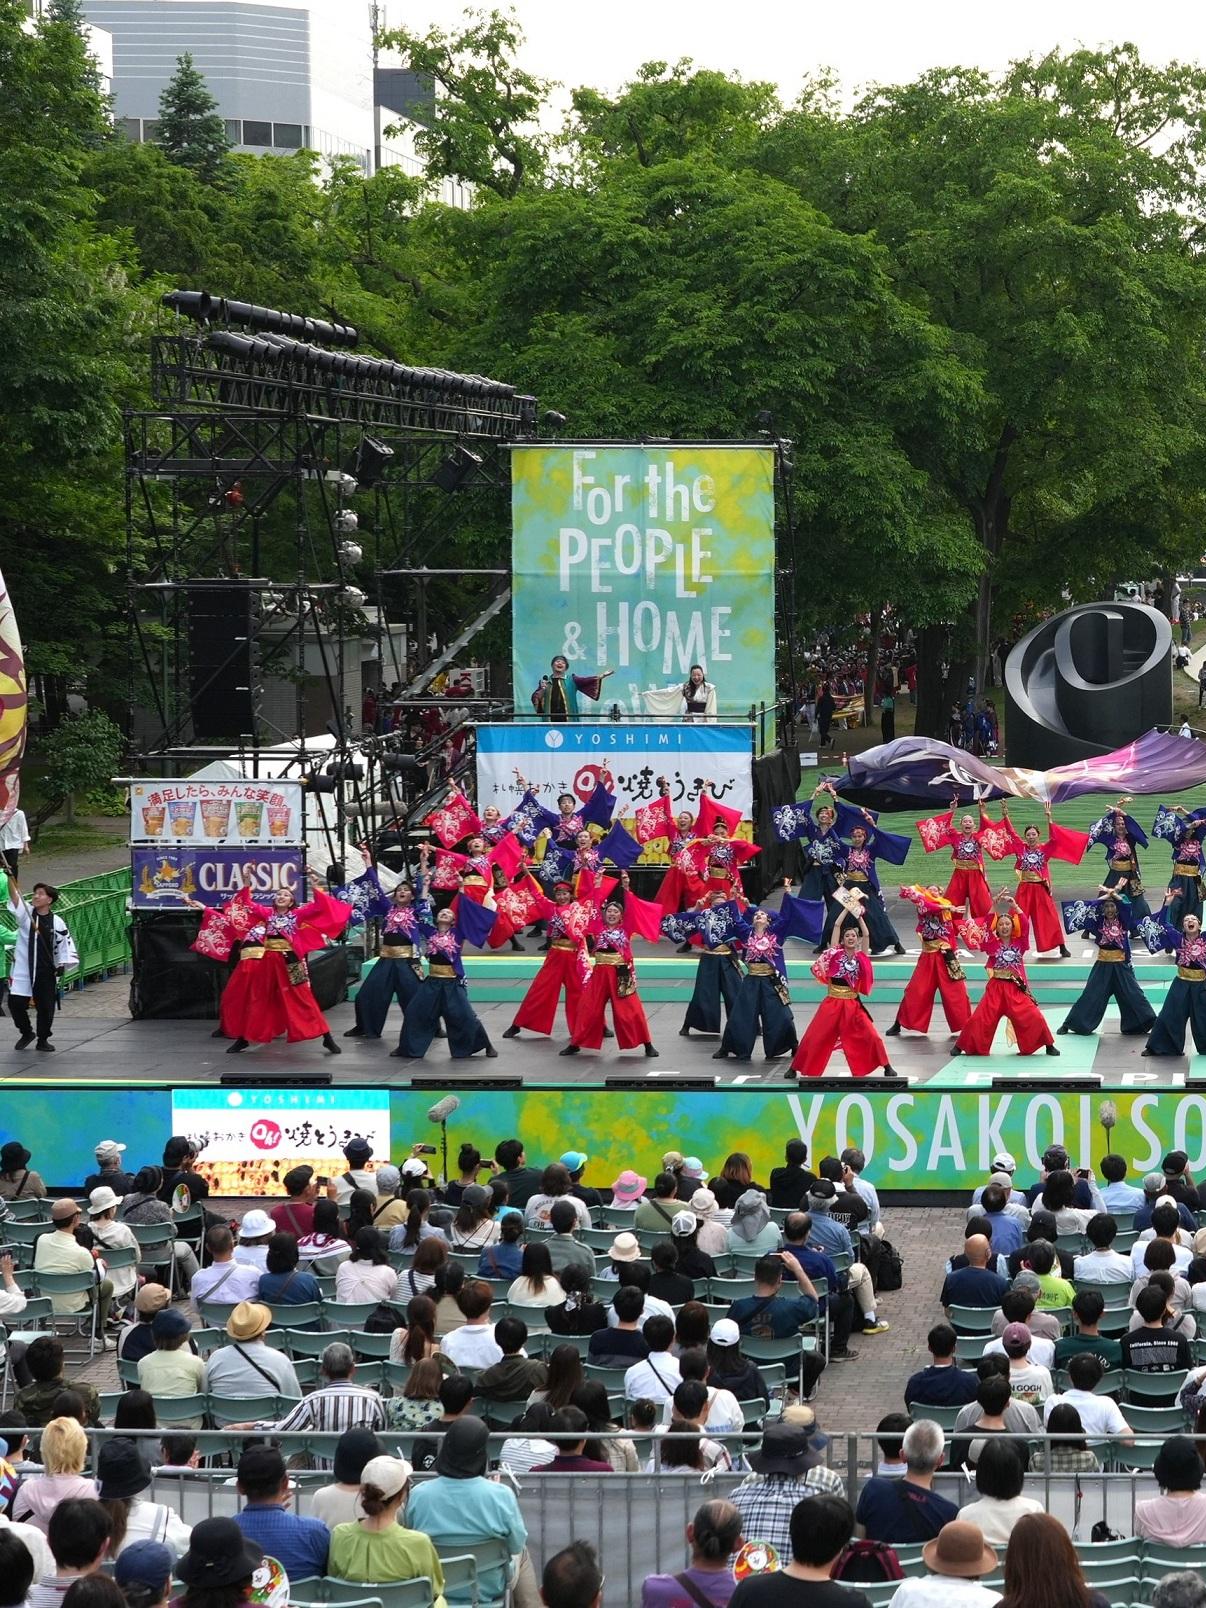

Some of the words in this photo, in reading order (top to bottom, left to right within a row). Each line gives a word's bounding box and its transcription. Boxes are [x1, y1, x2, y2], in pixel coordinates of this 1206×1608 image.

[572, 451, 631, 525] For
[645, 461, 716, 522] the
[559, 523, 713, 599] PEOPLE
[562, 621, 587, 661] &
[596, 600, 732, 675] HOME
[575, 733, 682, 745] YOSHIMI
[198, 862, 298, 892] CLASSIC
[251, 1096, 336, 1105] YOSHIMI
[786, 1094, 1091, 1172] YOSAKOI
[1016, 1384, 1042, 1392] GOGH
